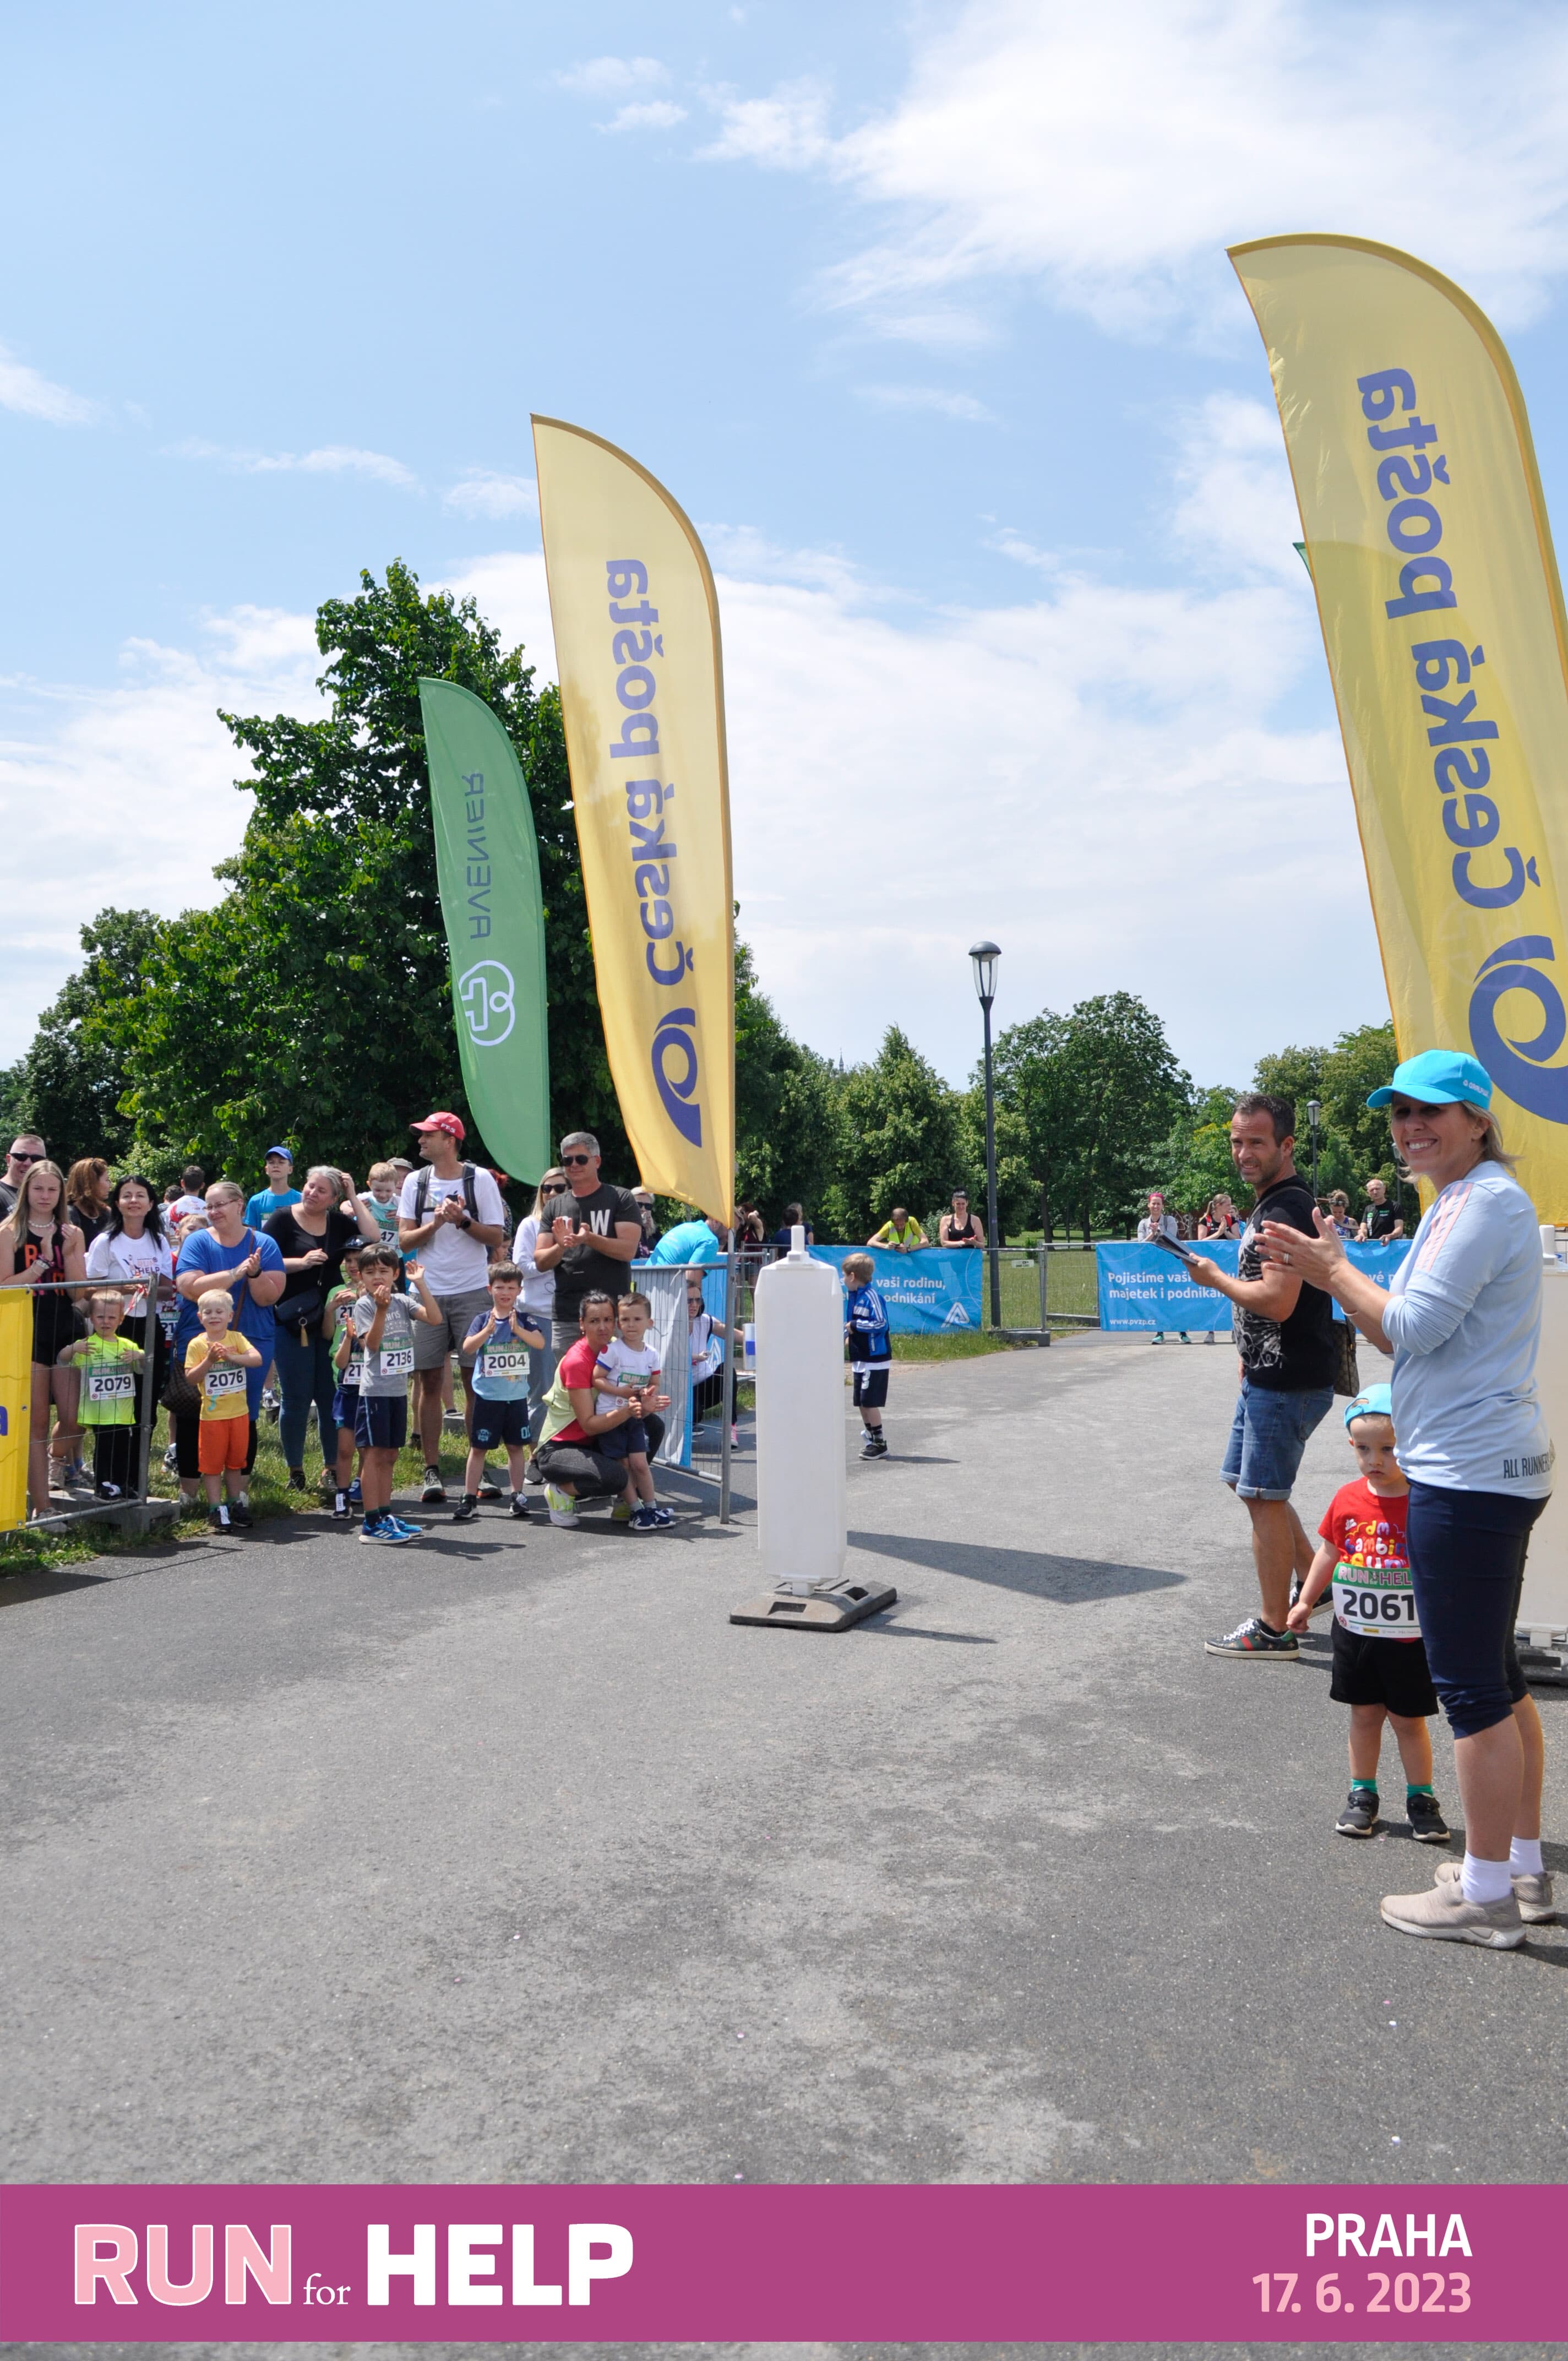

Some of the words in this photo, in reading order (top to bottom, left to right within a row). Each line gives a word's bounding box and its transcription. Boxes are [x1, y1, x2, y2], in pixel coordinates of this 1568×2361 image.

[380, 1231, 395, 1242] 47
[876, 1276, 900, 1288] vaši
[903, 1277, 946, 1291] rodinu,
[1108, 1271, 1164, 1285] Pojistíme
[1167, 1271, 1190, 1282] vaši
[884, 1292, 935, 1304] odnikání
[1109, 1287, 1157, 1301] majetek
[1161, 1287, 1164, 1298] i
[1168, 1287, 1225, 1301] podnikán
[340, 1306, 354, 1318] 21
[163, 1323, 176, 1334] 21
[386, 1350, 412, 1367] 2136
[488, 1354, 526, 1369] 2004
[94, 1376, 131, 1392] 2079
[209, 1370, 243, 1388] 2076
[1503, 1458, 1520, 1479] ALL
[1344, 1537, 1407, 1555] bambin
[1337, 1565, 1369, 1585] RUN
[1379, 1570, 1413, 1586] HEL
[1342, 1588, 1415, 1622] 2061
